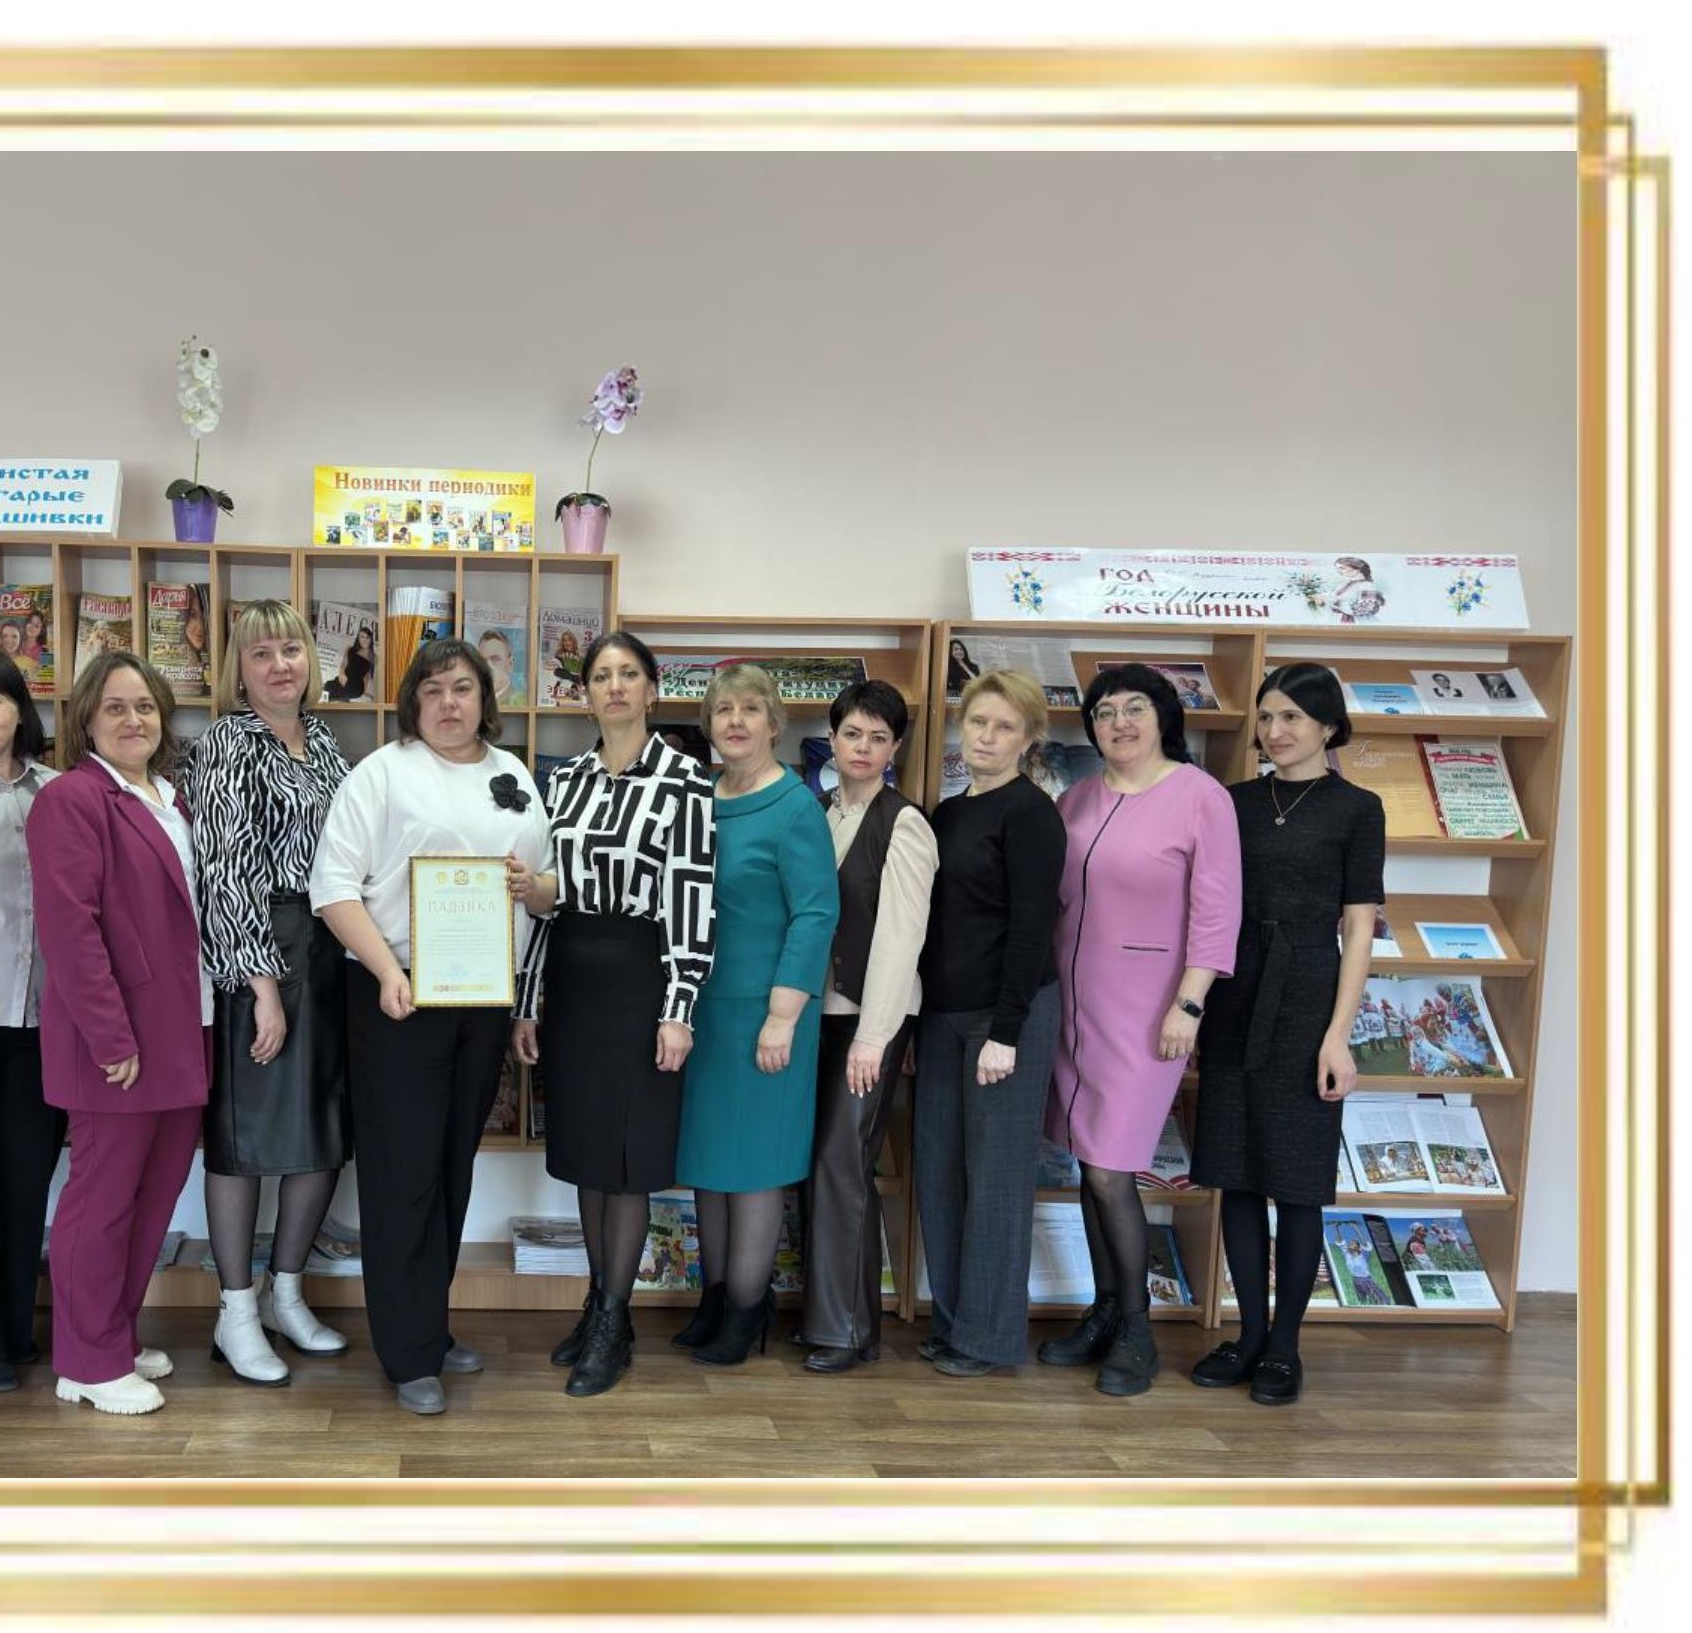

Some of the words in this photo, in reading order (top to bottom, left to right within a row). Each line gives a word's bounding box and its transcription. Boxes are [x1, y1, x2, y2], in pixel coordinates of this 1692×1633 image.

[334, 471, 422, 492] Новинки
[428, 479, 532, 497] периодики
[1099, 568, 1155, 583] ГОД
[1104, 601, 1270, 618] ЖЕНЩИНЫ
